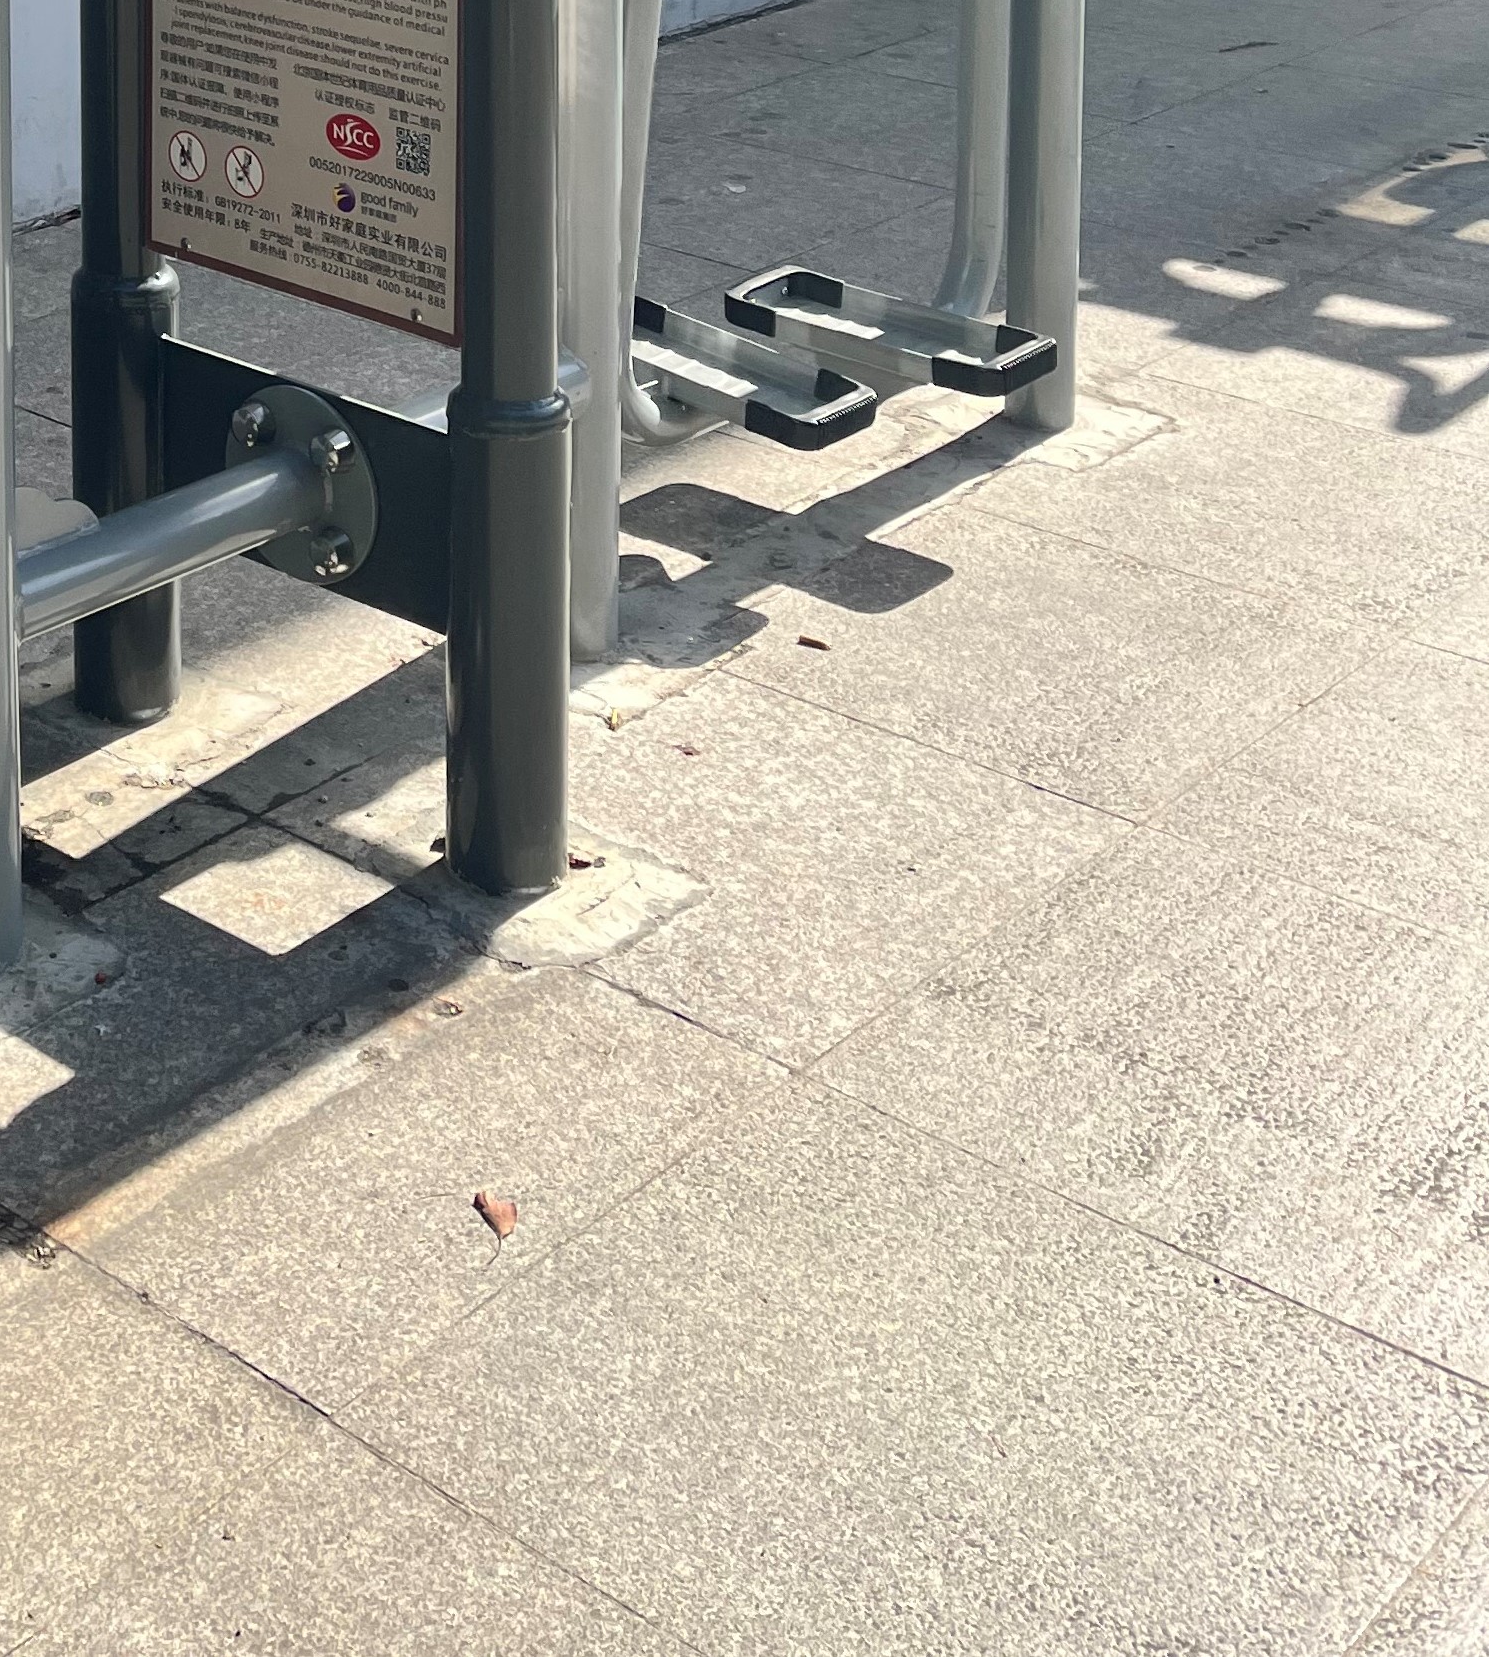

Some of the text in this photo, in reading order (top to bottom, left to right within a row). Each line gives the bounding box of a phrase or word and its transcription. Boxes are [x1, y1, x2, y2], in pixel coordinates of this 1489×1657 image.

[206, 0, 222, 12] with
[224, 3, 256, 20] balance
[312, 24, 338, 39] stroke
[384, 43, 414, 56] severe
[415, 50, 449, 65] cervica
[332, 0, 346, 14] the
[348, 6, 391, 23] guidance
[394, 15, 403, 26] of
[406, 20, 445, 36] medical
[384, 0, 412, 15] blood
[415, 8, 448, 22] pressu
[230, 20, 296, 43] cerebrovascular
[358, 50, 401, 70] extremity
[403, 60, 442, 77] artificial
[266, 39, 285, 53] joint
[286, 44, 318, 61] disease
[320, 53, 350, 68] should
[352, 61, 366, 72] not
[369, 63, 380, 75] do
[383, 66, 398, 80] this
[401, 73, 442, 90] exercise.
[314, 88, 442, 133] 认证授权标志 监管二维码
[332, 119, 374, 149] NSCC
[309, 156, 436, 201] 0052017229005N00633
[360, 192, 419, 218] good family
[291, 202, 447, 262] 深圳市好家庭实业有限公司
[376, 278, 446, 309] 4000-844-888
